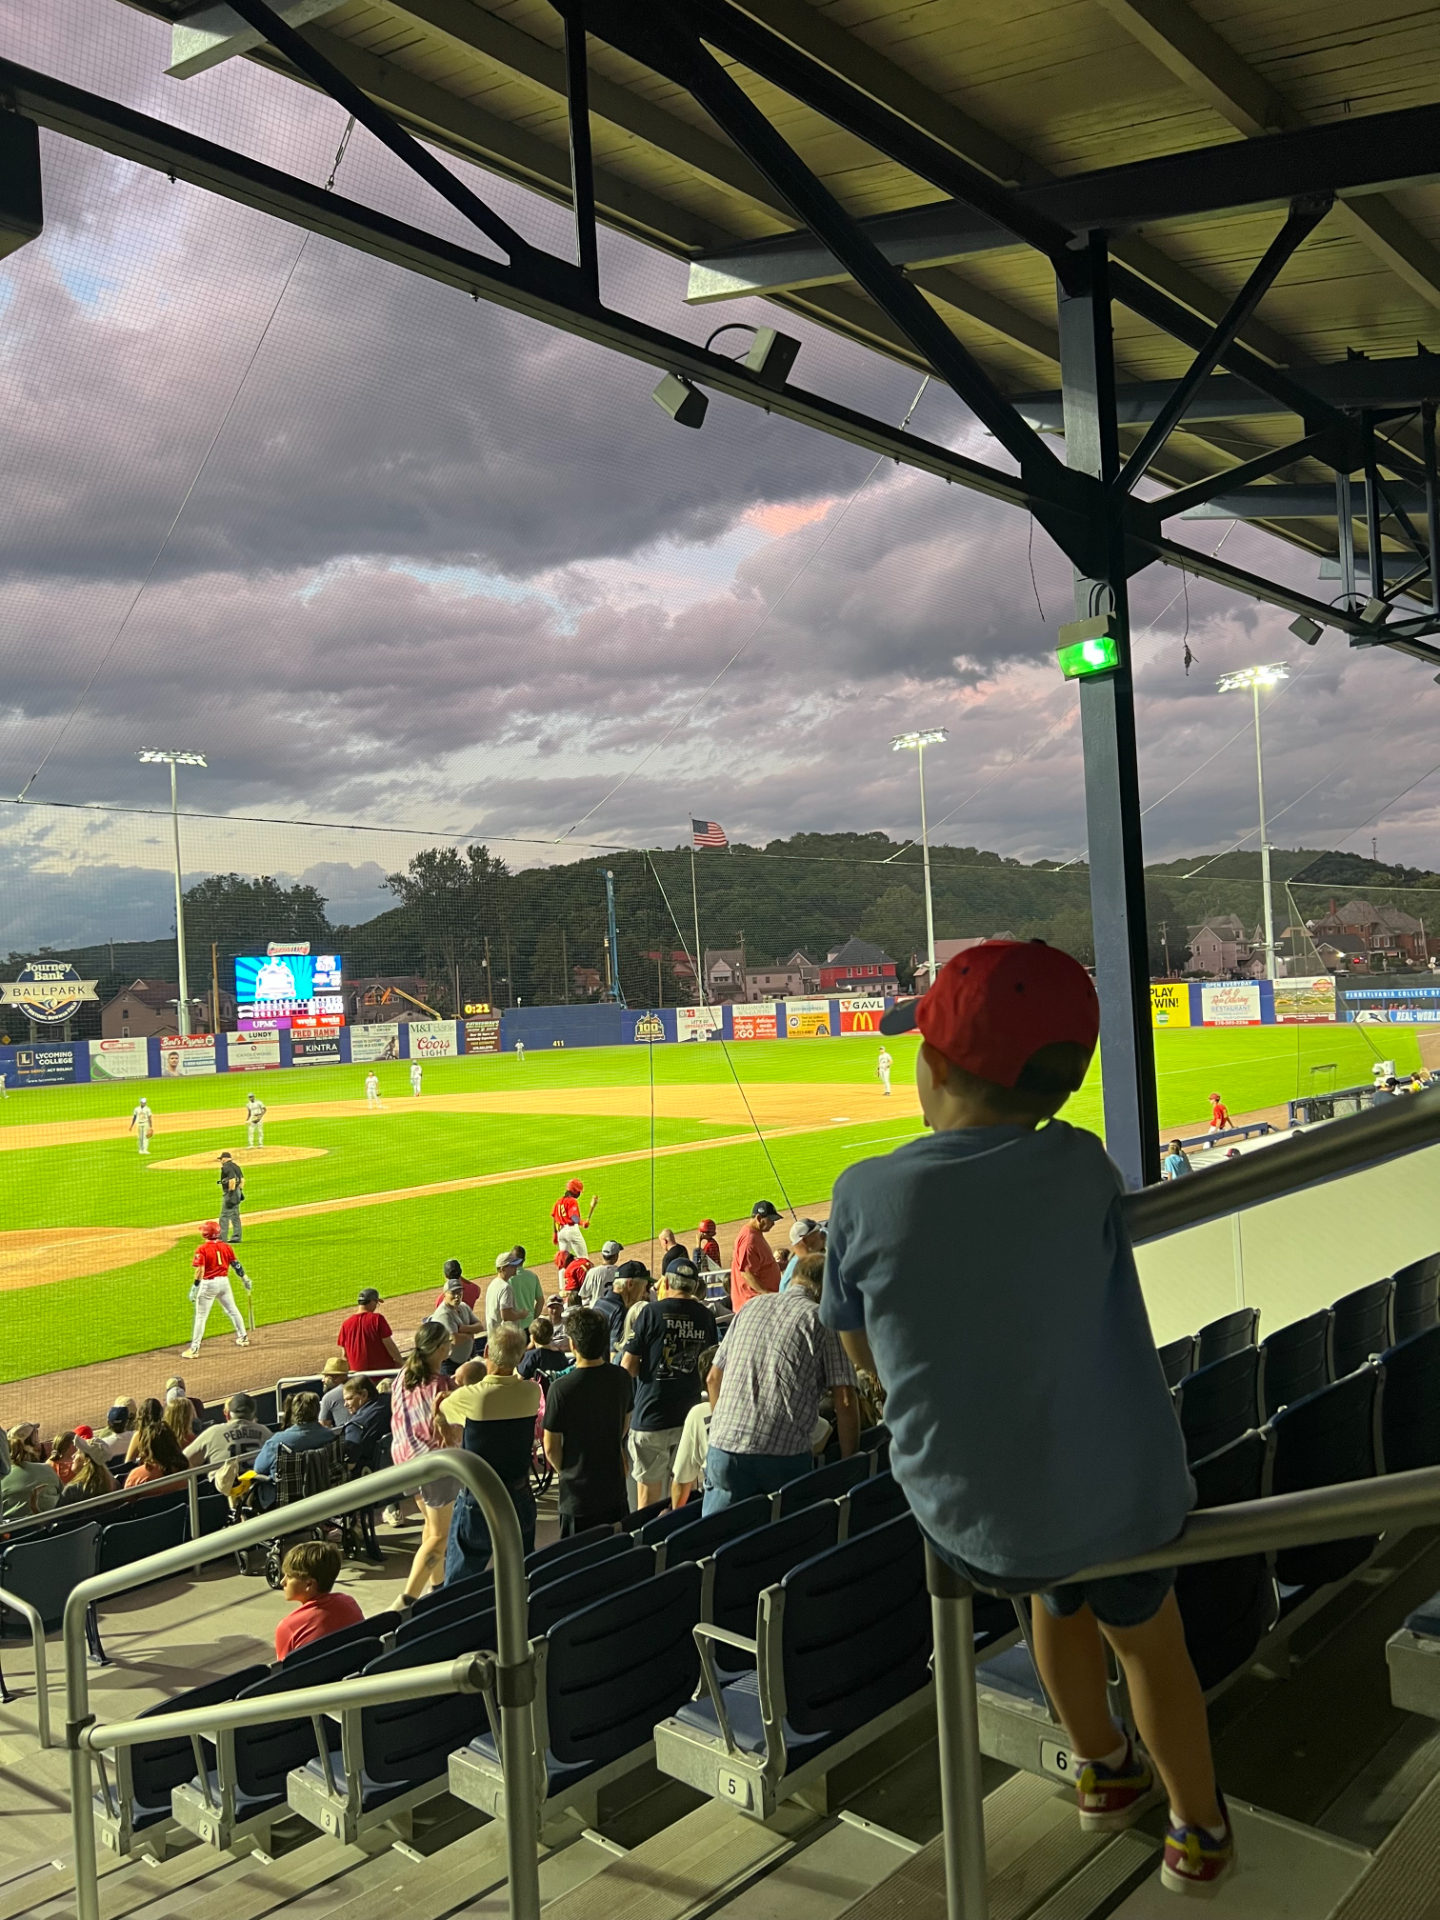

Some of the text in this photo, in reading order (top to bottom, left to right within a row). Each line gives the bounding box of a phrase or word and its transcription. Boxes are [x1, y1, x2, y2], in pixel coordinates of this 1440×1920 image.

[25, 962, 72, 973] Journey
[34, 971, 65, 981] Bank
[13, 986, 86, 997] BALLPARK
[1150, 987, 1174, 998] PLAY
[853, 1001, 883, 1009] GAVL
[1155, 998, 1179, 1008] WIN!
[464, 1003, 490, 1014] 0:21
[253, 1020, 277, 1028] UPMC
[411, 1023, 431, 1033] M&T
[639, 1023, 659, 1032] 100
[249, 1031, 272, 1039] LUNDY
[292, 1028, 336, 1038] FRED HAMM
[735, 1029, 754, 1038] 2GO
[305, 1043, 338, 1052] KINTRA
[416, 1036, 450, 1050] Coors
[35, 1051, 73, 1060] LYCOMING
[422, 1049, 448, 1057] LIGHT
[21, 1053, 31, 1064] L
[39, 1057, 73, 1065] COLLEGE
[558, 1204, 567, 1217] 12
[216, 1250, 223, 1265] 1
[667, 1319, 694, 1330] RAH!
[678, 1329, 705, 1340] RAH!
[1056, 1751, 1067, 1771] 6
[728, 1778, 736, 1795] 5
[325, 1814, 331, 1827] 3
[202, 1824, 208, 1836] 2
[105, 1833, 110, 1843] 1
